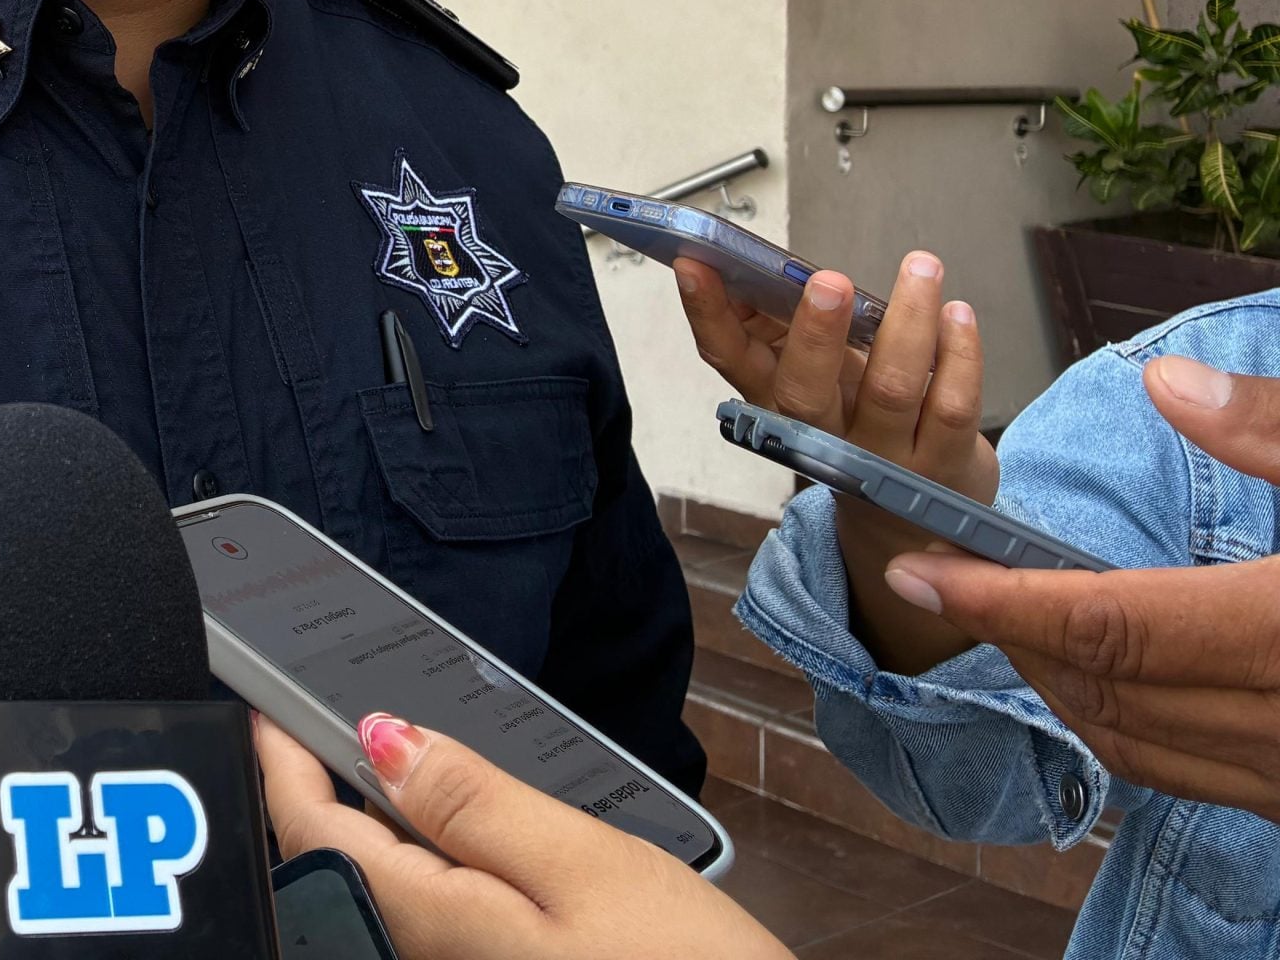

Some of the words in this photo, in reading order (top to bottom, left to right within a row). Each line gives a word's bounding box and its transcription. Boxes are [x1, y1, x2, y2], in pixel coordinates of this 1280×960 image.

[608, 779, 650, 803] Todas
[592, 796, 620, 813] las
[8, 780, 198, 922] LP
